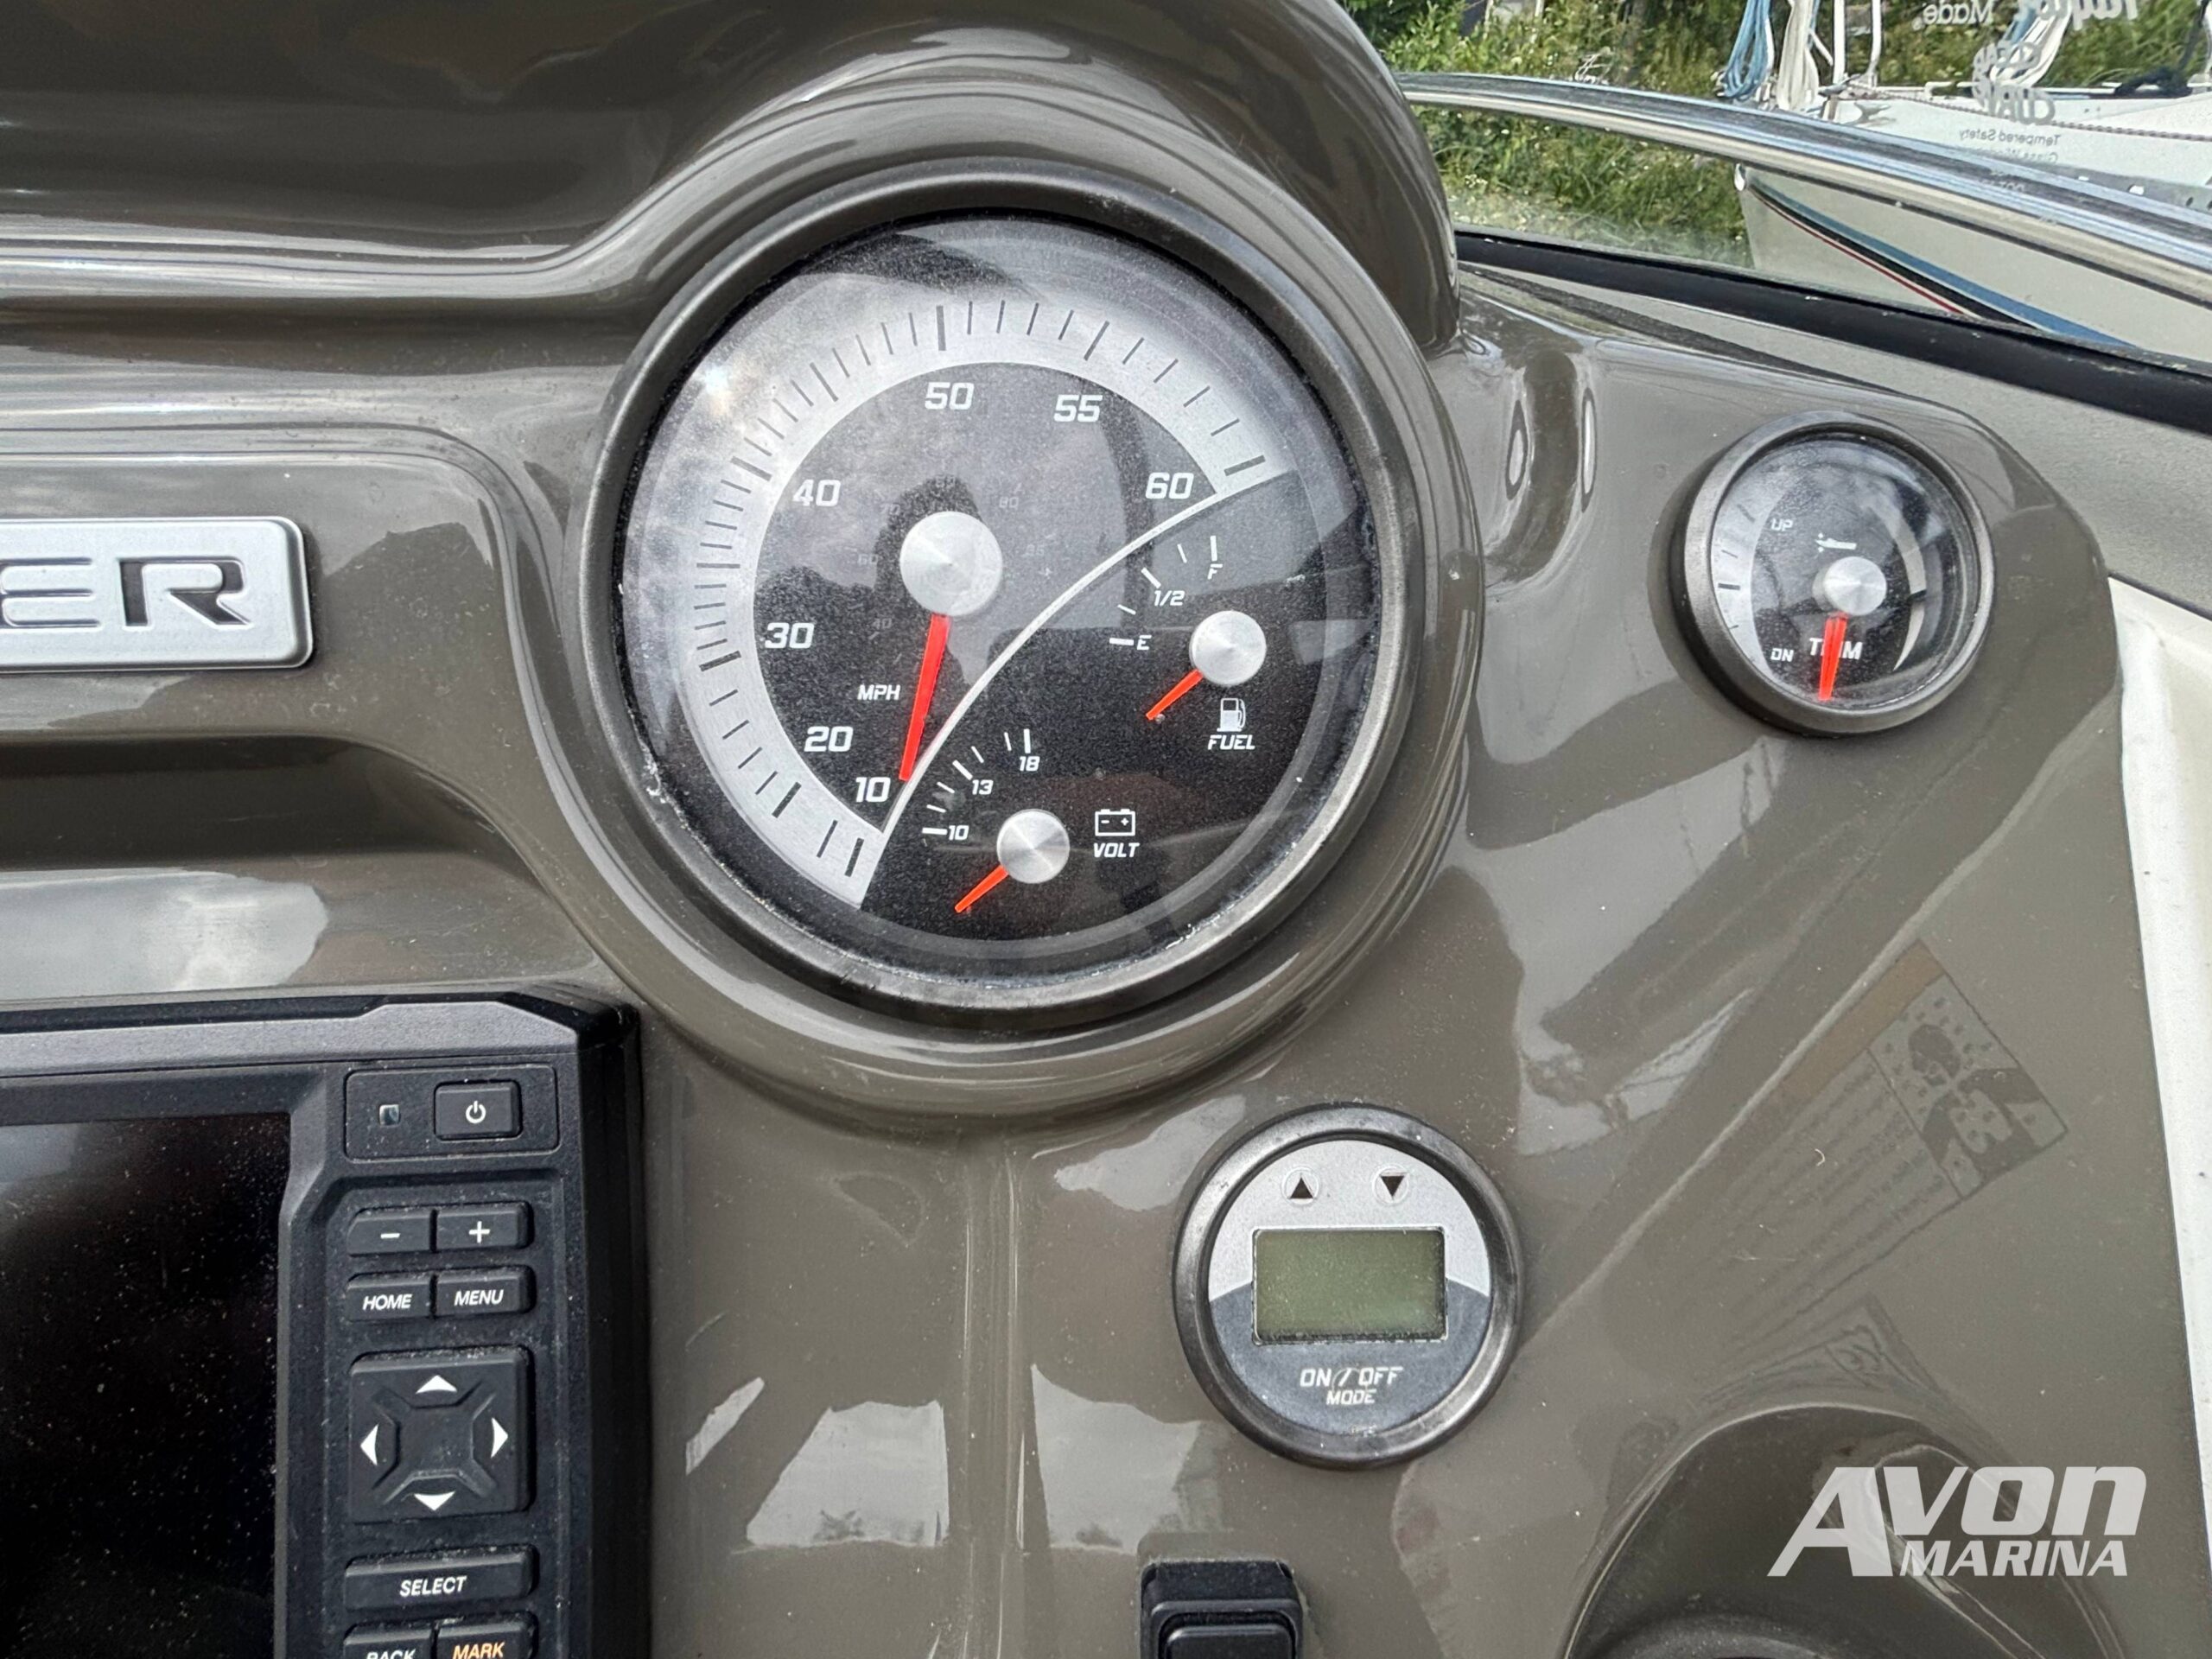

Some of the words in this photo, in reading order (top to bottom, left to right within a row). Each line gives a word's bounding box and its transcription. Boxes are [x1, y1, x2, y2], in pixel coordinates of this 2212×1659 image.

[925, 382, 975, 410] 50
[1053, 394, 1103, 423] 55
[792, 479, 840, 506] 40
[1145, 472, 1194, 499] 60
[1770, 518, 1794, 531] UP
[1207, 563, 1224, 580] F
[1154, 589, 1185, 607] 1/2
[764, 622, 814, 650] 30
[1136, 634, 1153, 651] E
[1808, 637, 1863, 660] TM
[857, 683, 901, 701] MPH
[804, 726, 853, 753] 20
[1207, 734, 1255, 751] FUEL
[1019, 756, 1040, 772] 18
[855, 777, 890, 803] 10
[970, 779, 994, 795] 13
[948, 824, 969, 841] 10
[1093, 842, 1140, 858] VOLT
[362, 1294, 413, 1311] HOME
[454, 1289, 505, 1306] MENU
[1325, 1388, 1377, 1406] MODE
[398, 1574, 467, 1598] SELECT
[452, 1641, 505, 1659] MARK
